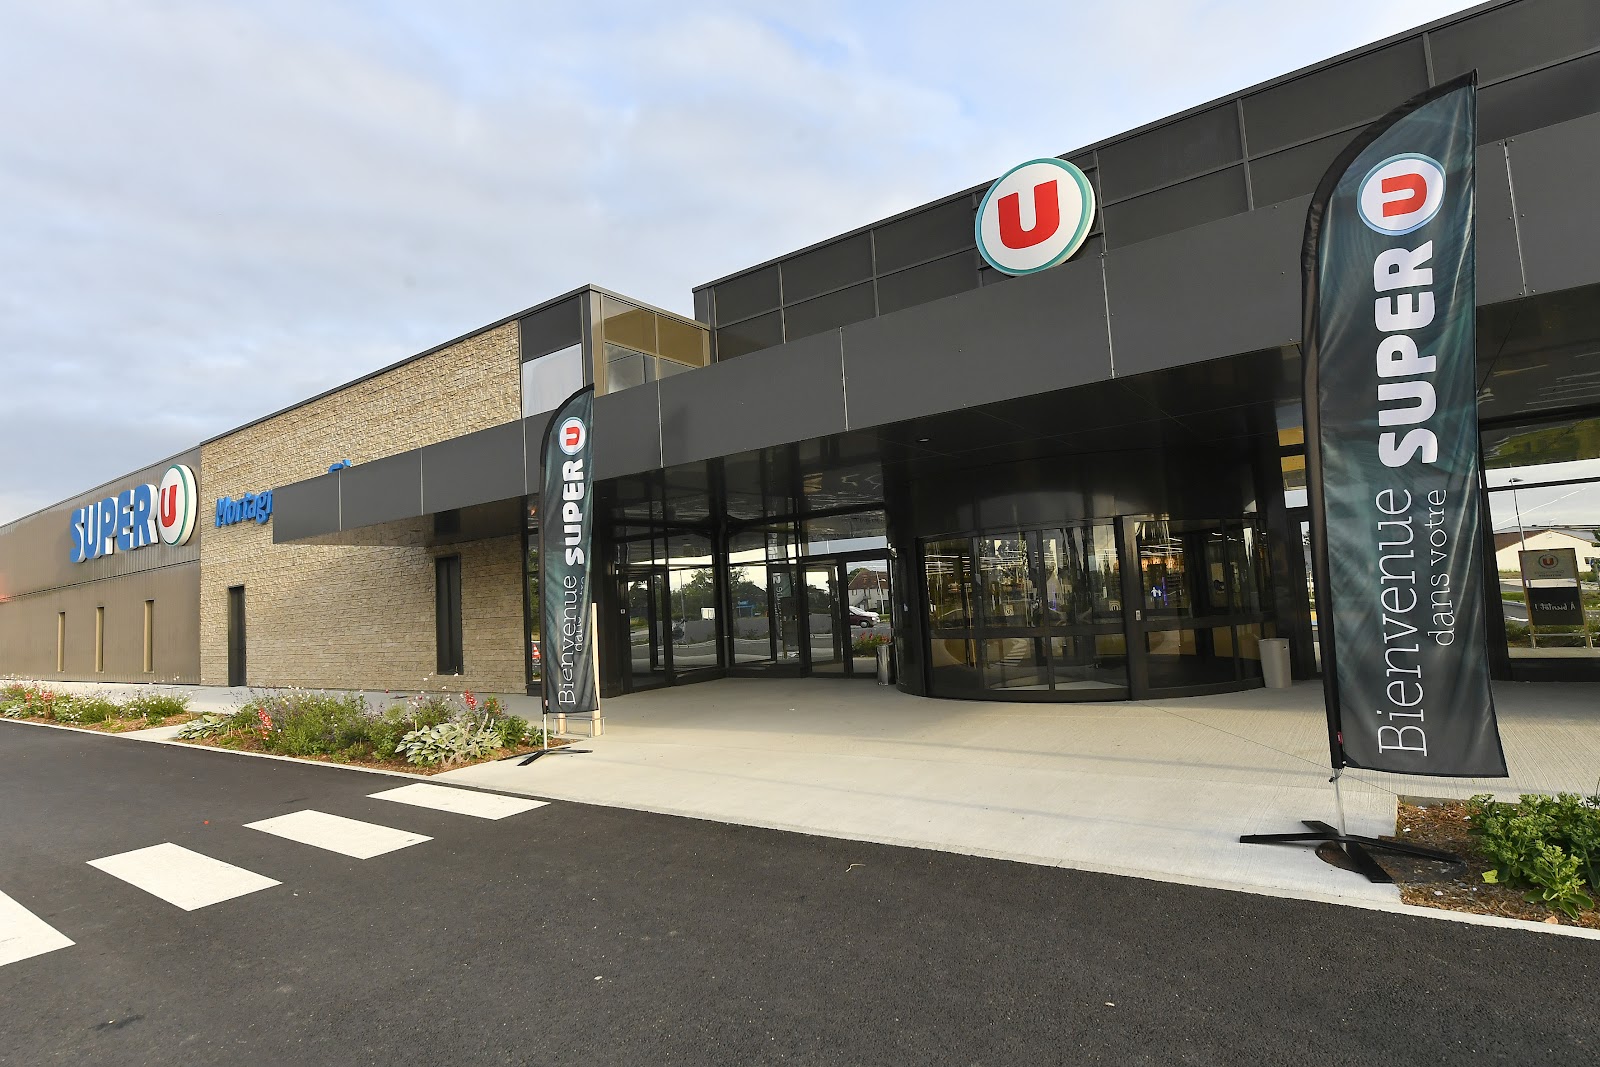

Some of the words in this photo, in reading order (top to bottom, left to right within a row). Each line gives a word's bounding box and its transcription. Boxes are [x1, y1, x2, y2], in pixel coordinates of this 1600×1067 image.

[997, 179, 1060, 250] U
[1381, 173, 1427, 218] U
[1373, 239, 1438, 468] SUPER
[565, 426, 581, 446] U
[69, 483, 158, 563] SUPER
[160, 484, 178, 528] U
[562, 458, 585, 567] SUPER
[1424, 488, 1448, 567] votre
[558, 575, 577, 705] Bienvenue
[1375, 488, 1428, 757] Bienvenue
[1427, 572, 1456, 647] dans
